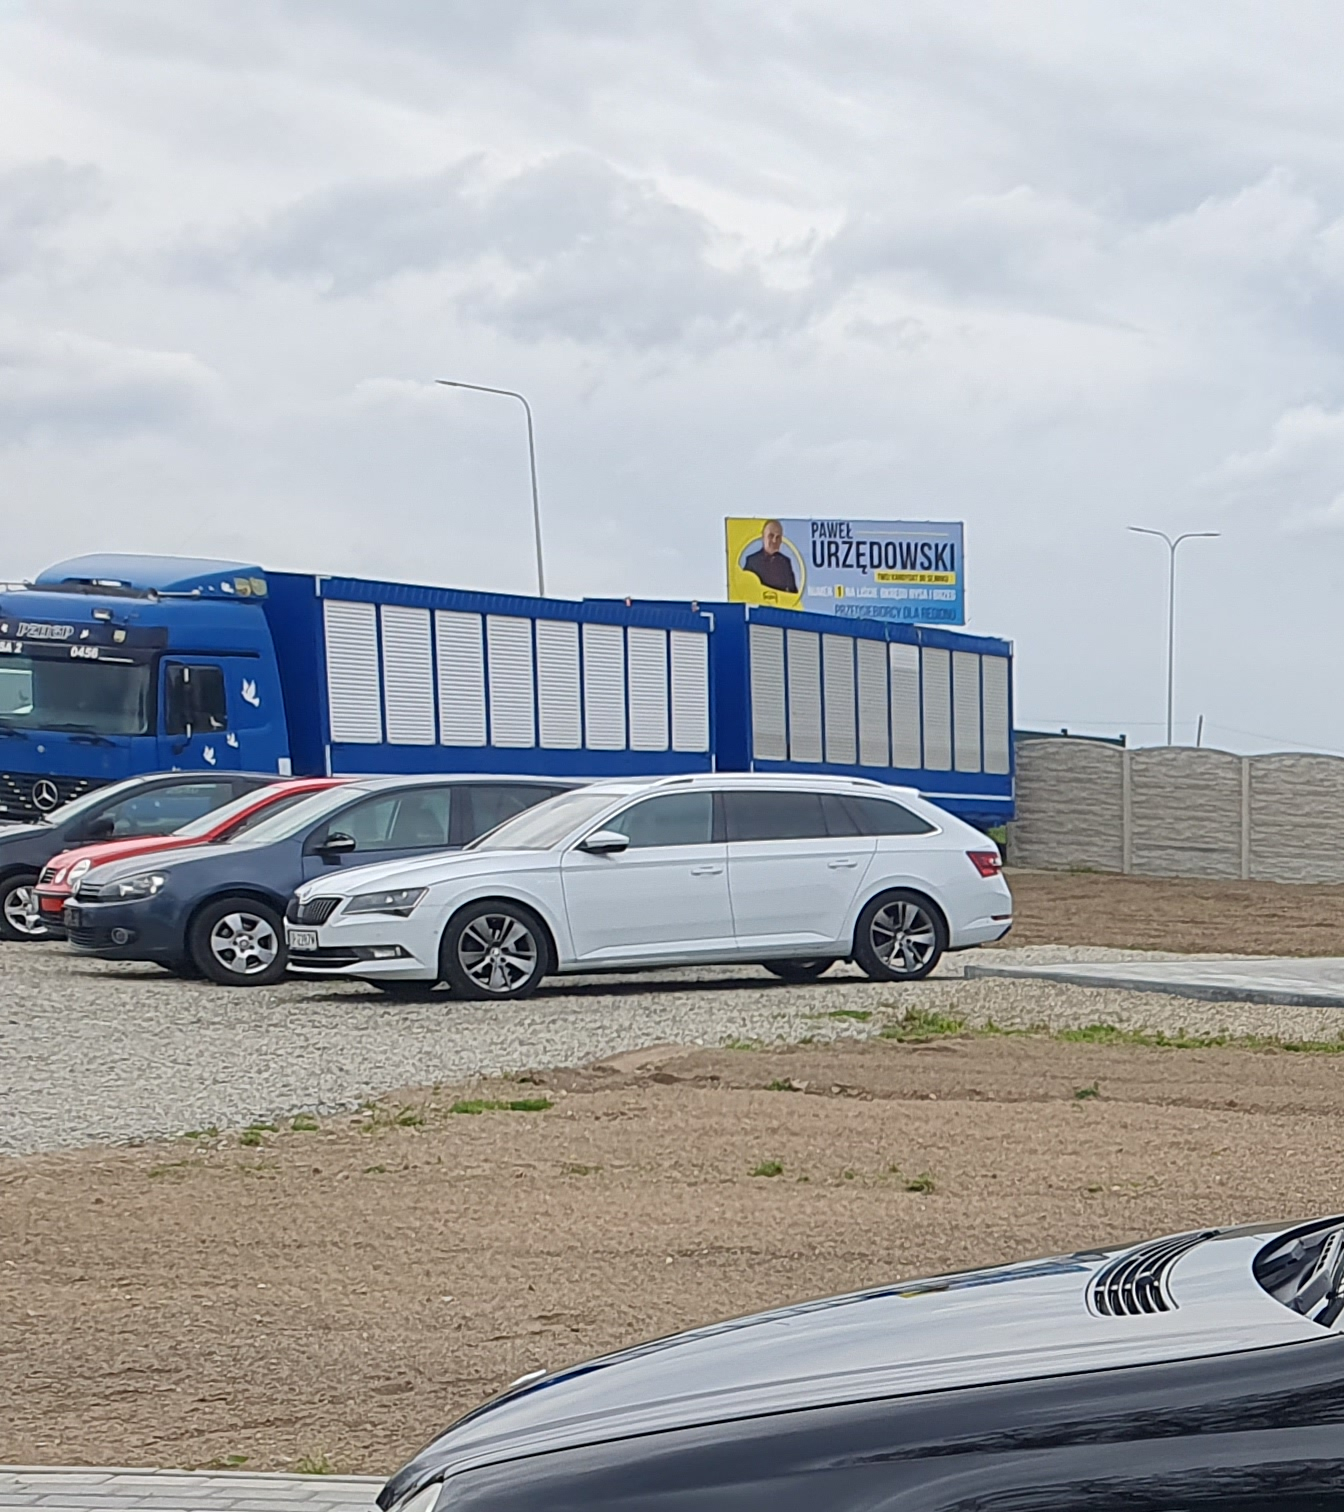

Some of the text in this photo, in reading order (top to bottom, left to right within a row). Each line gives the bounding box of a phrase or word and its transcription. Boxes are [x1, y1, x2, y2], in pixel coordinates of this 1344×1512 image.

[811, 521, 853, 540] PAWEŁ
[811, 540, 956, 574] URZĘDOWSKI
[903, 605, 919, 620] DLA
